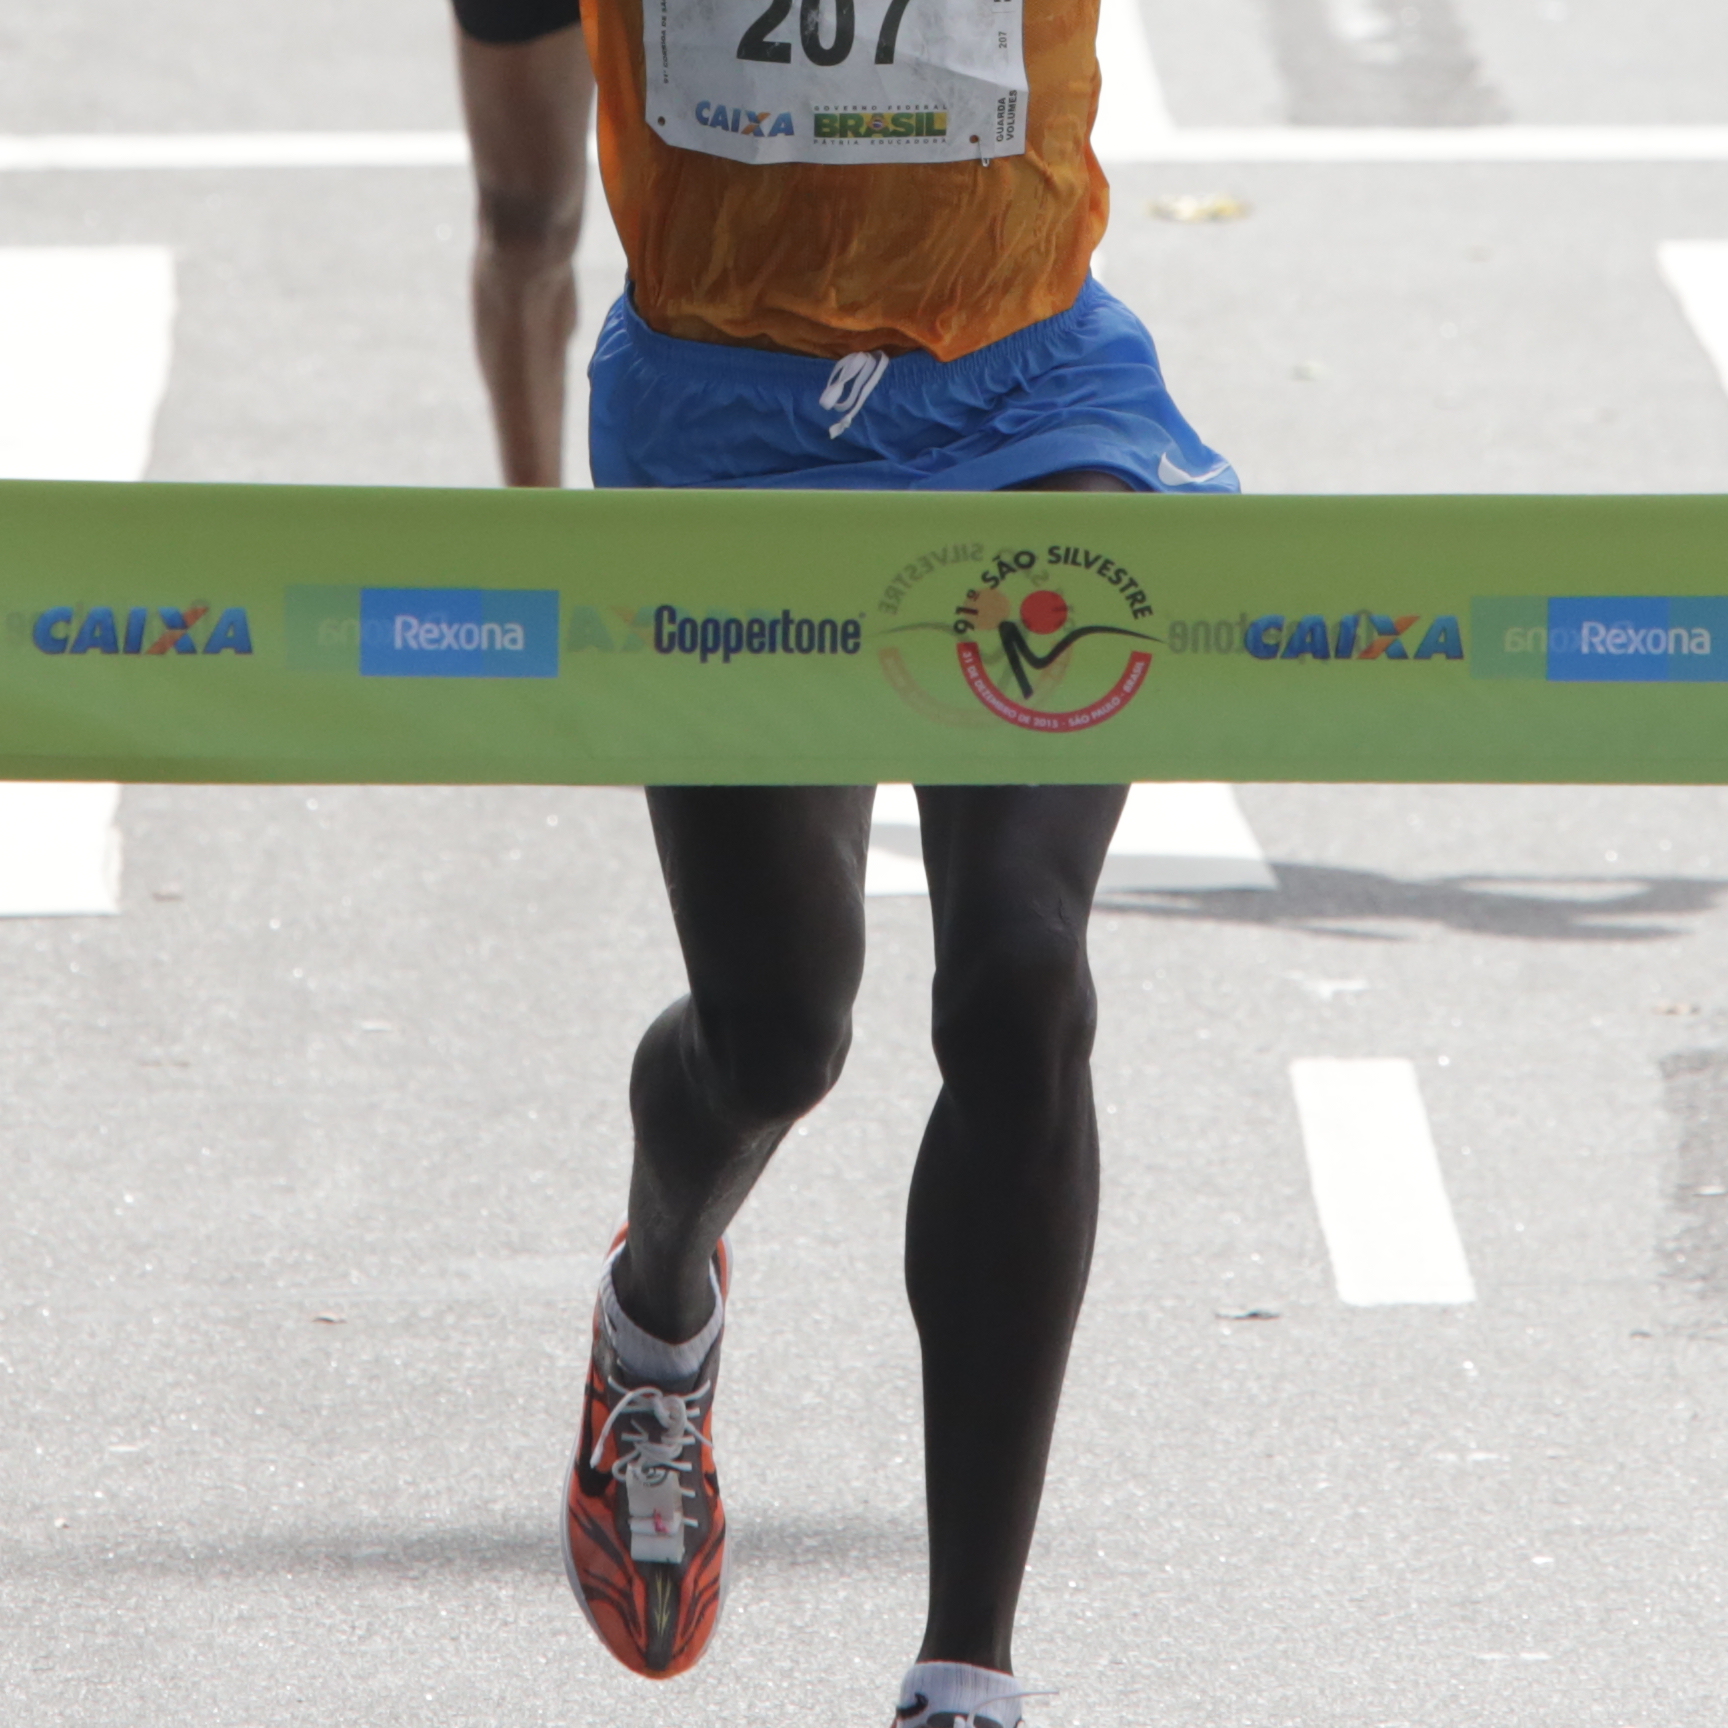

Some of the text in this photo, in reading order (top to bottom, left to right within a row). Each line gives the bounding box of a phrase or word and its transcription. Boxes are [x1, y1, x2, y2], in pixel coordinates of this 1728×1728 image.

[998, 31, 1008, 49] 207
[695, 100, 795, 137] CAIXA
[814, 112, 947, 138] BRASIL
[995, 97, 1007, 143] GUARDA
[1005, 89, 1018, 141] VOLUMES
[981, 551, 1036, 590] SÃO
[1047, 545, 1154, 620] SILVESTRE
[32, 606, 254, 656] CAIXA
[393, 614, 524, 651] Rexona
[654, 604, 862, 663] Coppertone
[1244, 614, 1464, 660] CAIXA
[1580, 621, 1711, 655] Rexona
[963, 650, 1143, 728] 31 DE DEZEMBRO DE 2015 SÃO PAULO BRASIL
